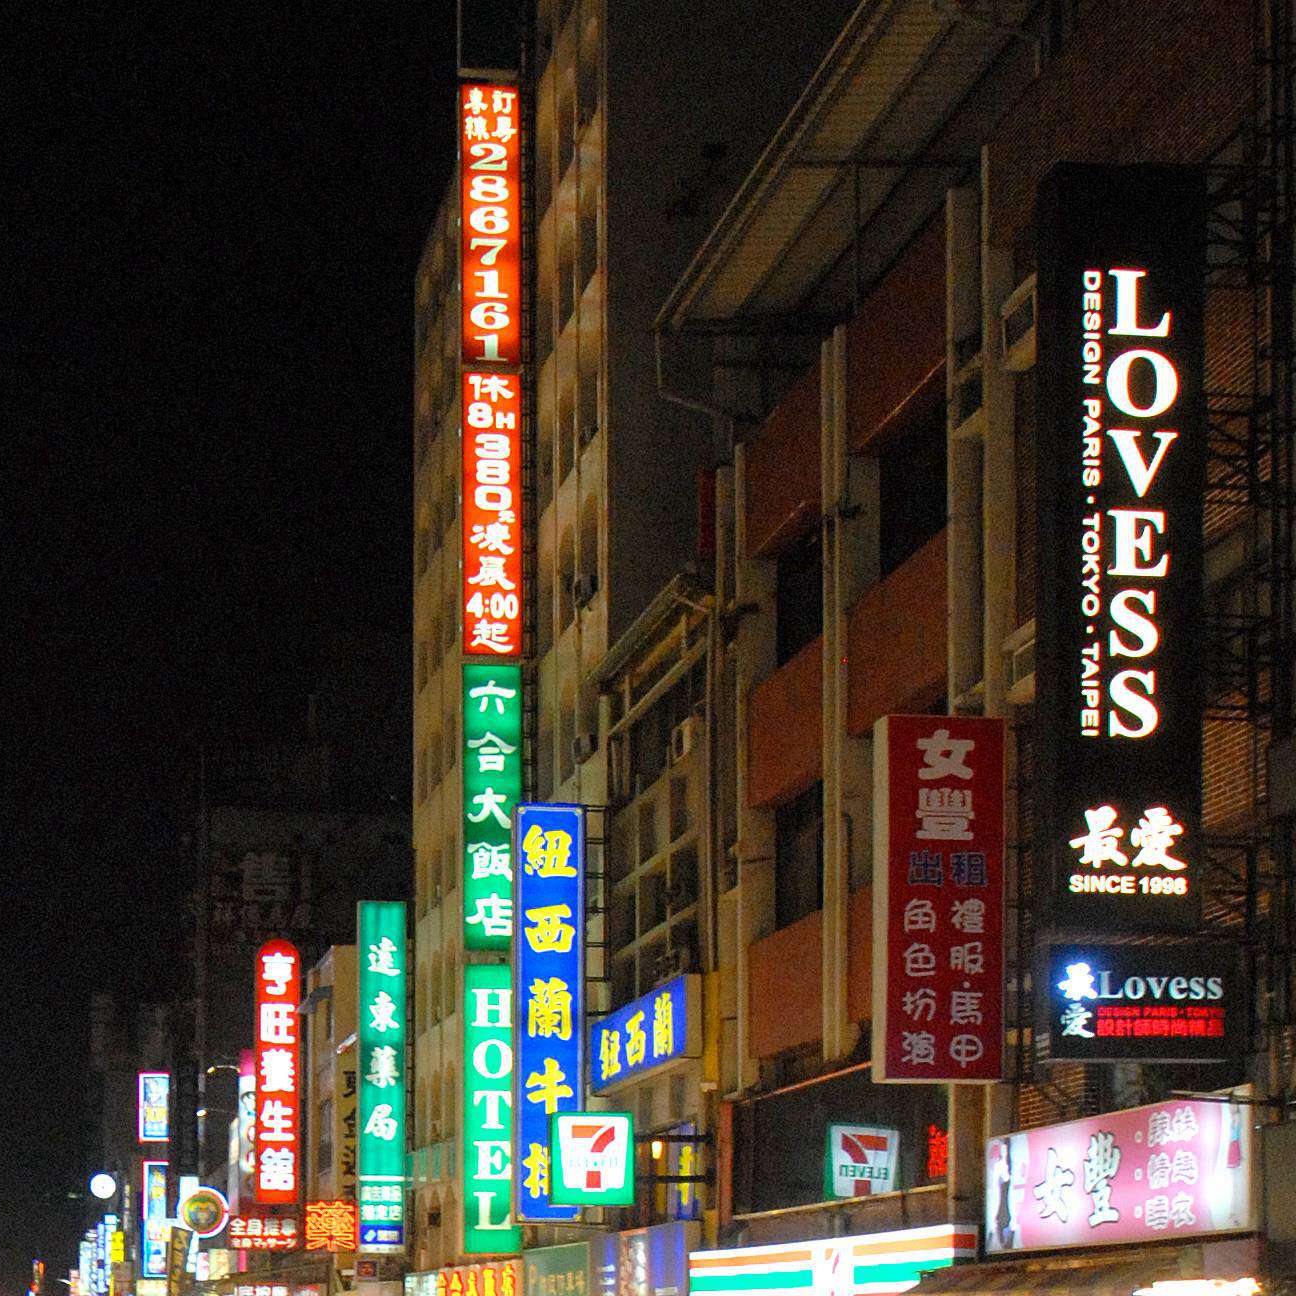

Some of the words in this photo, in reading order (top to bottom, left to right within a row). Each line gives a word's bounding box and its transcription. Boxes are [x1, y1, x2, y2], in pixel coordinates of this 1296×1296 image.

[468, 143, 510, 361] 2867161
[1082, 270, 1102, 385] DESIGN
[1081, 399, 1101, 487] PARIS
[1106, 268, 1179, 738] LOVESS
[1081, 513, 1101, 617] TOKYO
[1080, 642, 1100, 737] TAIPEI
[466, 680, 516, 936] 六合大飯店
[1069, 805, 1187, 870] 最愛
[1069, 875, 1136, 894] SINCE
[599, 992, 674, 1080] 紐西蘭
[901, 898, 937, 1066] 角色扮演
[1097, 970, 1224, 1000] Lovess
[260, 953, 296, 1190] 亨旺養生館
[471, 988, 511, 1231] HOTEL
